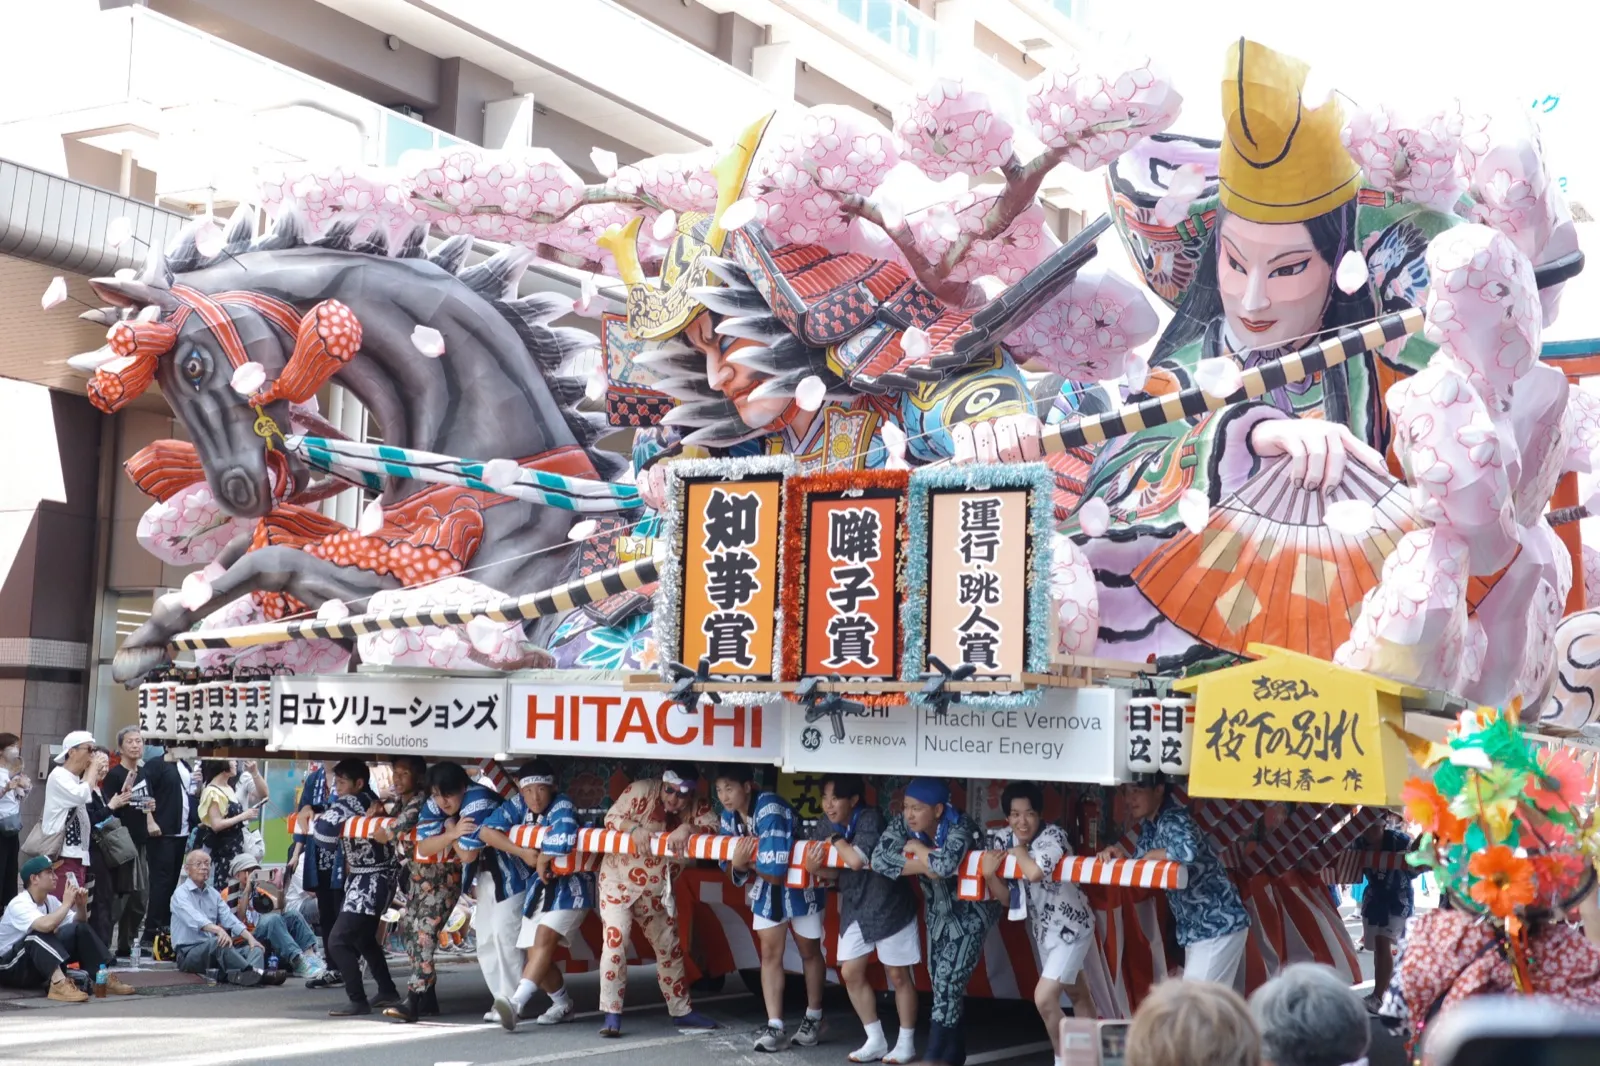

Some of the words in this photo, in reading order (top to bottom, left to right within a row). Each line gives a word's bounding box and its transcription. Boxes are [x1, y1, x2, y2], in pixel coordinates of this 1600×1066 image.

[823, 508, 881, 668] 囃子賞
[208, 687, 225, 732] 日立
[245, 687, 259, 732] 日立
[1252, 676, 1319, 701] 吉野山
[175, 692, 191, 735] 日立
[279, 692, 499, 731] 日立ソリューションズ
[526, 695, 762, 748] HITACHI
[925, 711, 985, 727] Hitachi
[992, 711, 1018, 728] GE
[1024, 712, 1102, 730] Vernova
[335, 733, 373, 746] Hitachi
[376, 733, 429, 748] Solutions
[849, 735, 907, 746] VERNOVA
[925, 735, 993, 753] Nuclear
[999, 737, 1064, 759] Energy
[1129, 705, 1151, 764] 日立
[1161, 705, 1183, 766] 日立
[1205, 707, 1365, 762] 桜下の別れ
